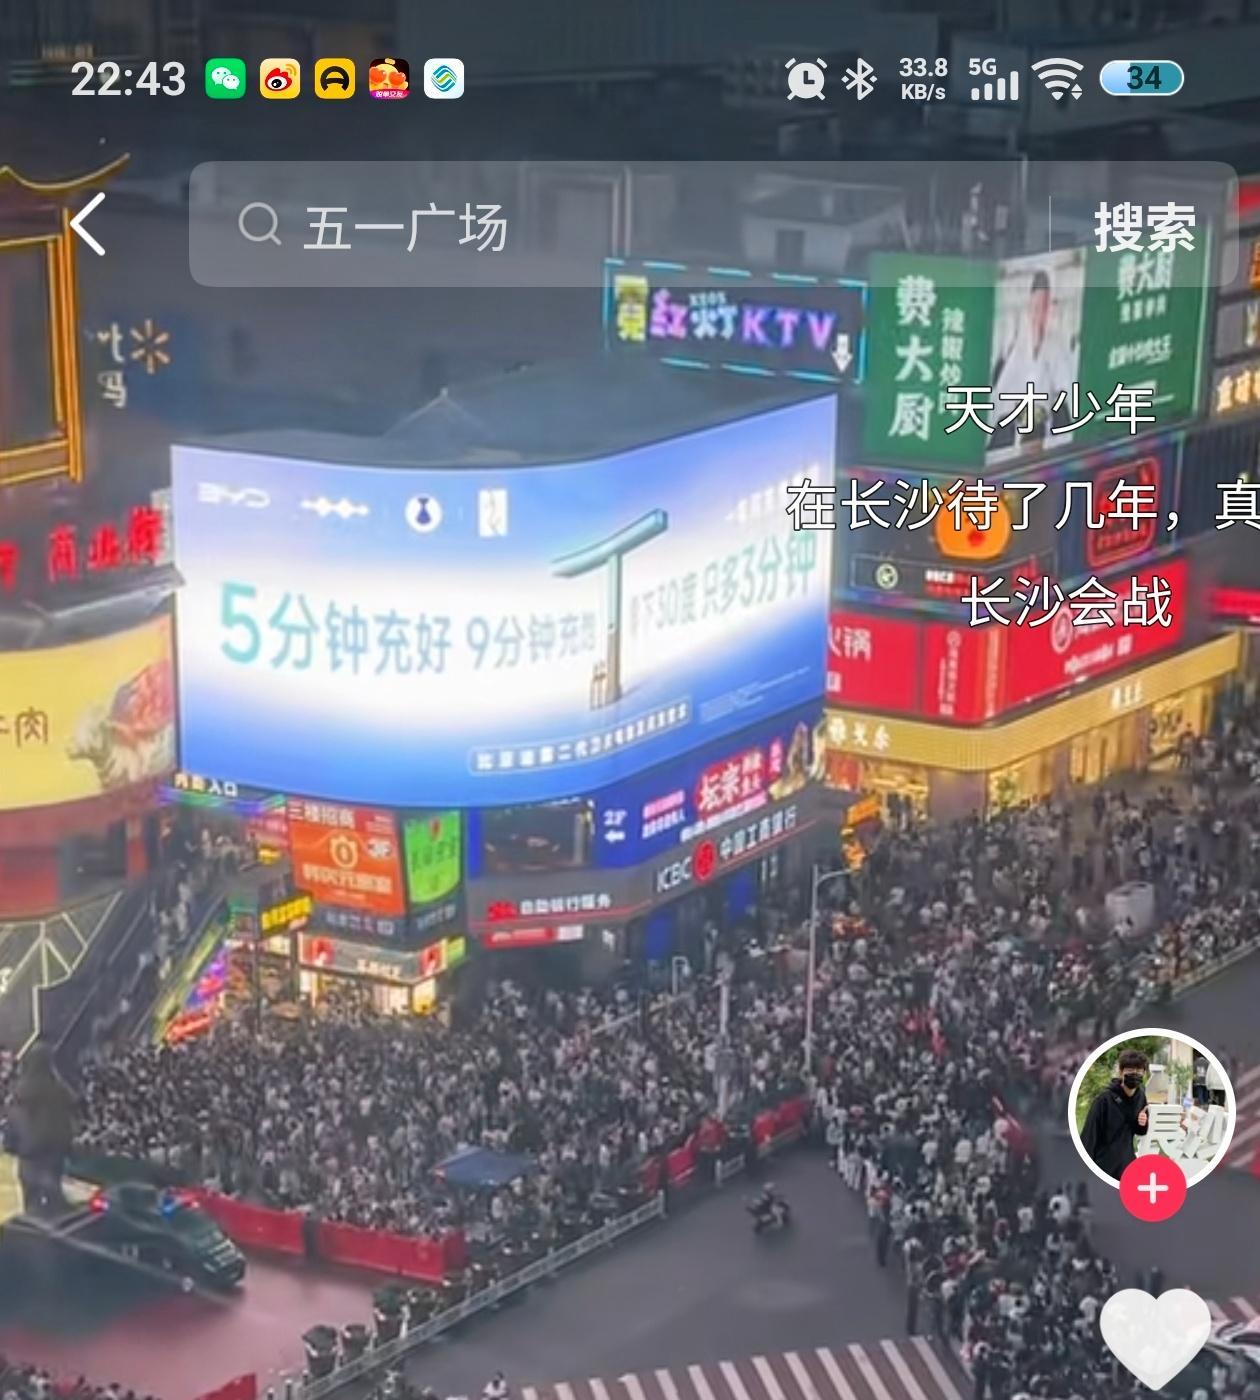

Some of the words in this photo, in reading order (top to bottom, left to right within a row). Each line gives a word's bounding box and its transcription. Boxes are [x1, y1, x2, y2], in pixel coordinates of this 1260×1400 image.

[888, 275, 937, 441] 费大厨
[220, 581, 453, 675] 5分钟充好
[656, 856, 693, 893] ICBC
